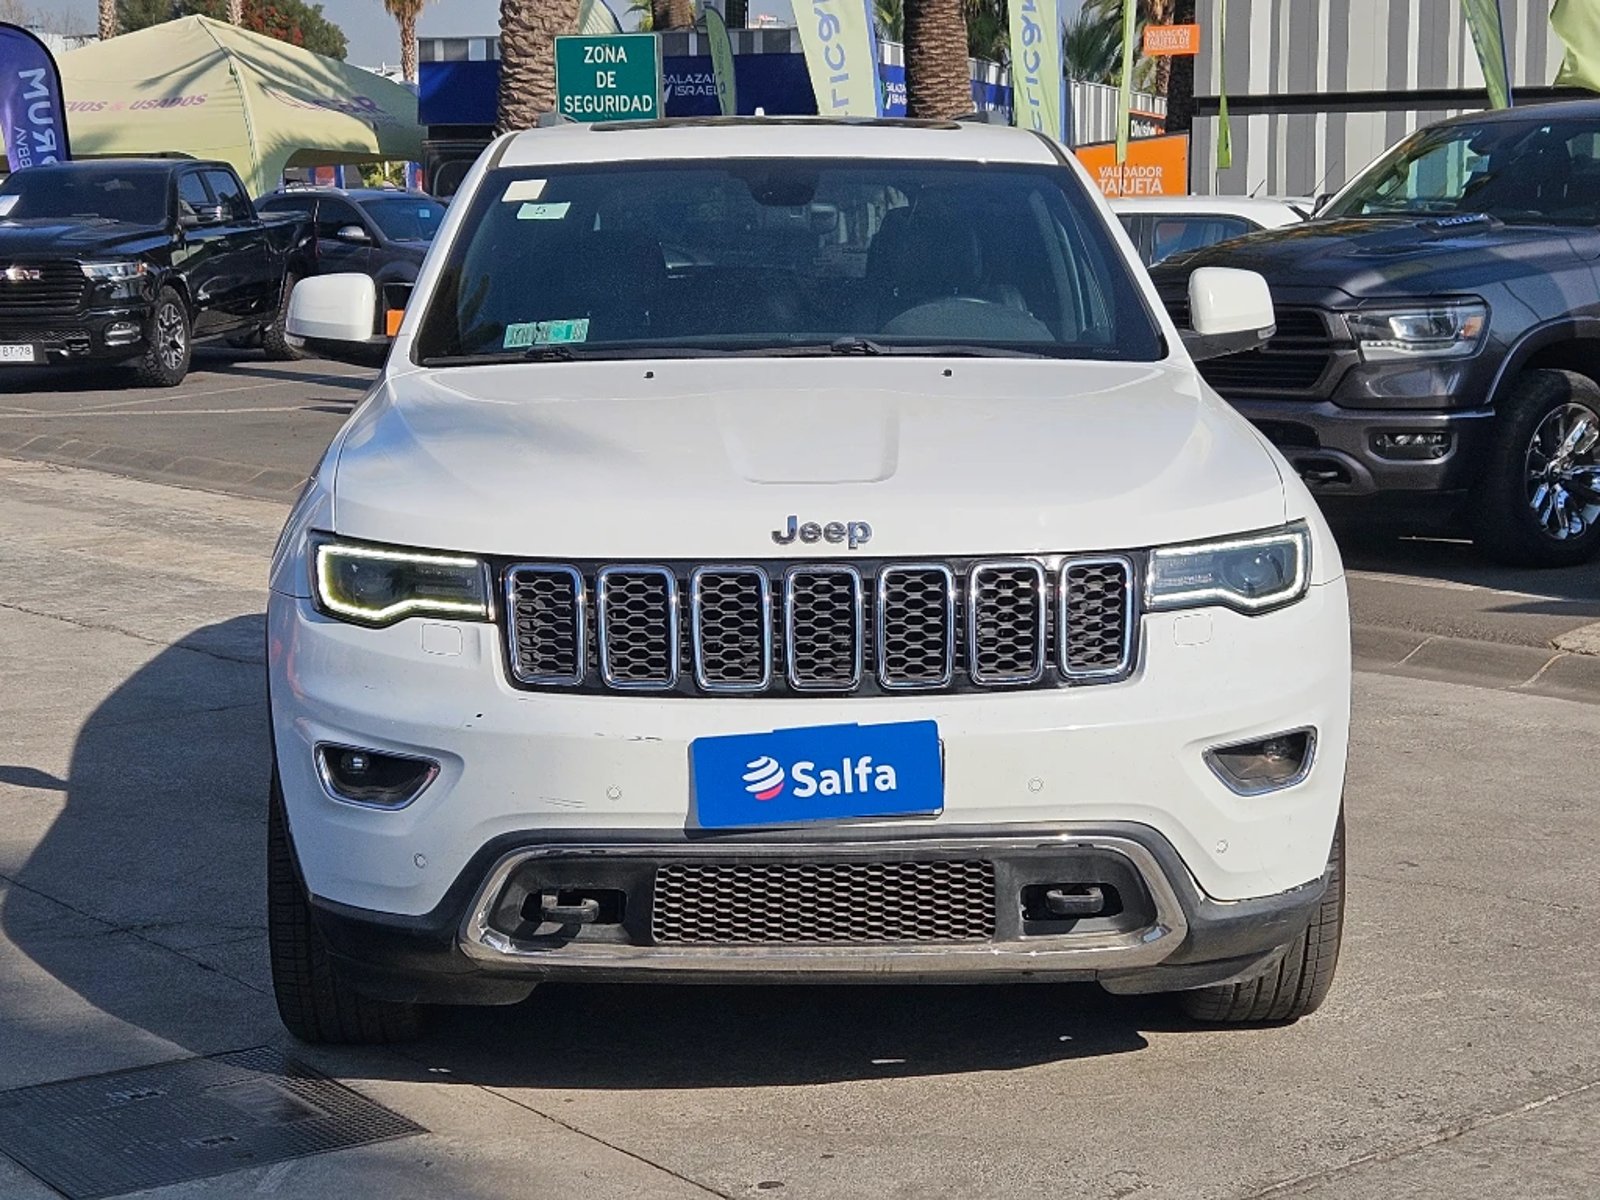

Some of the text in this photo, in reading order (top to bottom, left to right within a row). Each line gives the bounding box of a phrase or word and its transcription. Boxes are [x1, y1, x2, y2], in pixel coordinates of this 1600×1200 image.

[584, 46, 628, 63] ZONA
[596, 71, 617, 88] DE
[129, 93, 208, 110] USADOS
[564, 95, 653, 113] SEGURIDAD
[1098, 166, 1163, 177] VALIDADOR
[1098, 178, 1164, 194] TARJETA
[771, 515, 873, 550] Jeep
[791, 755, 897, 798] Salfa
